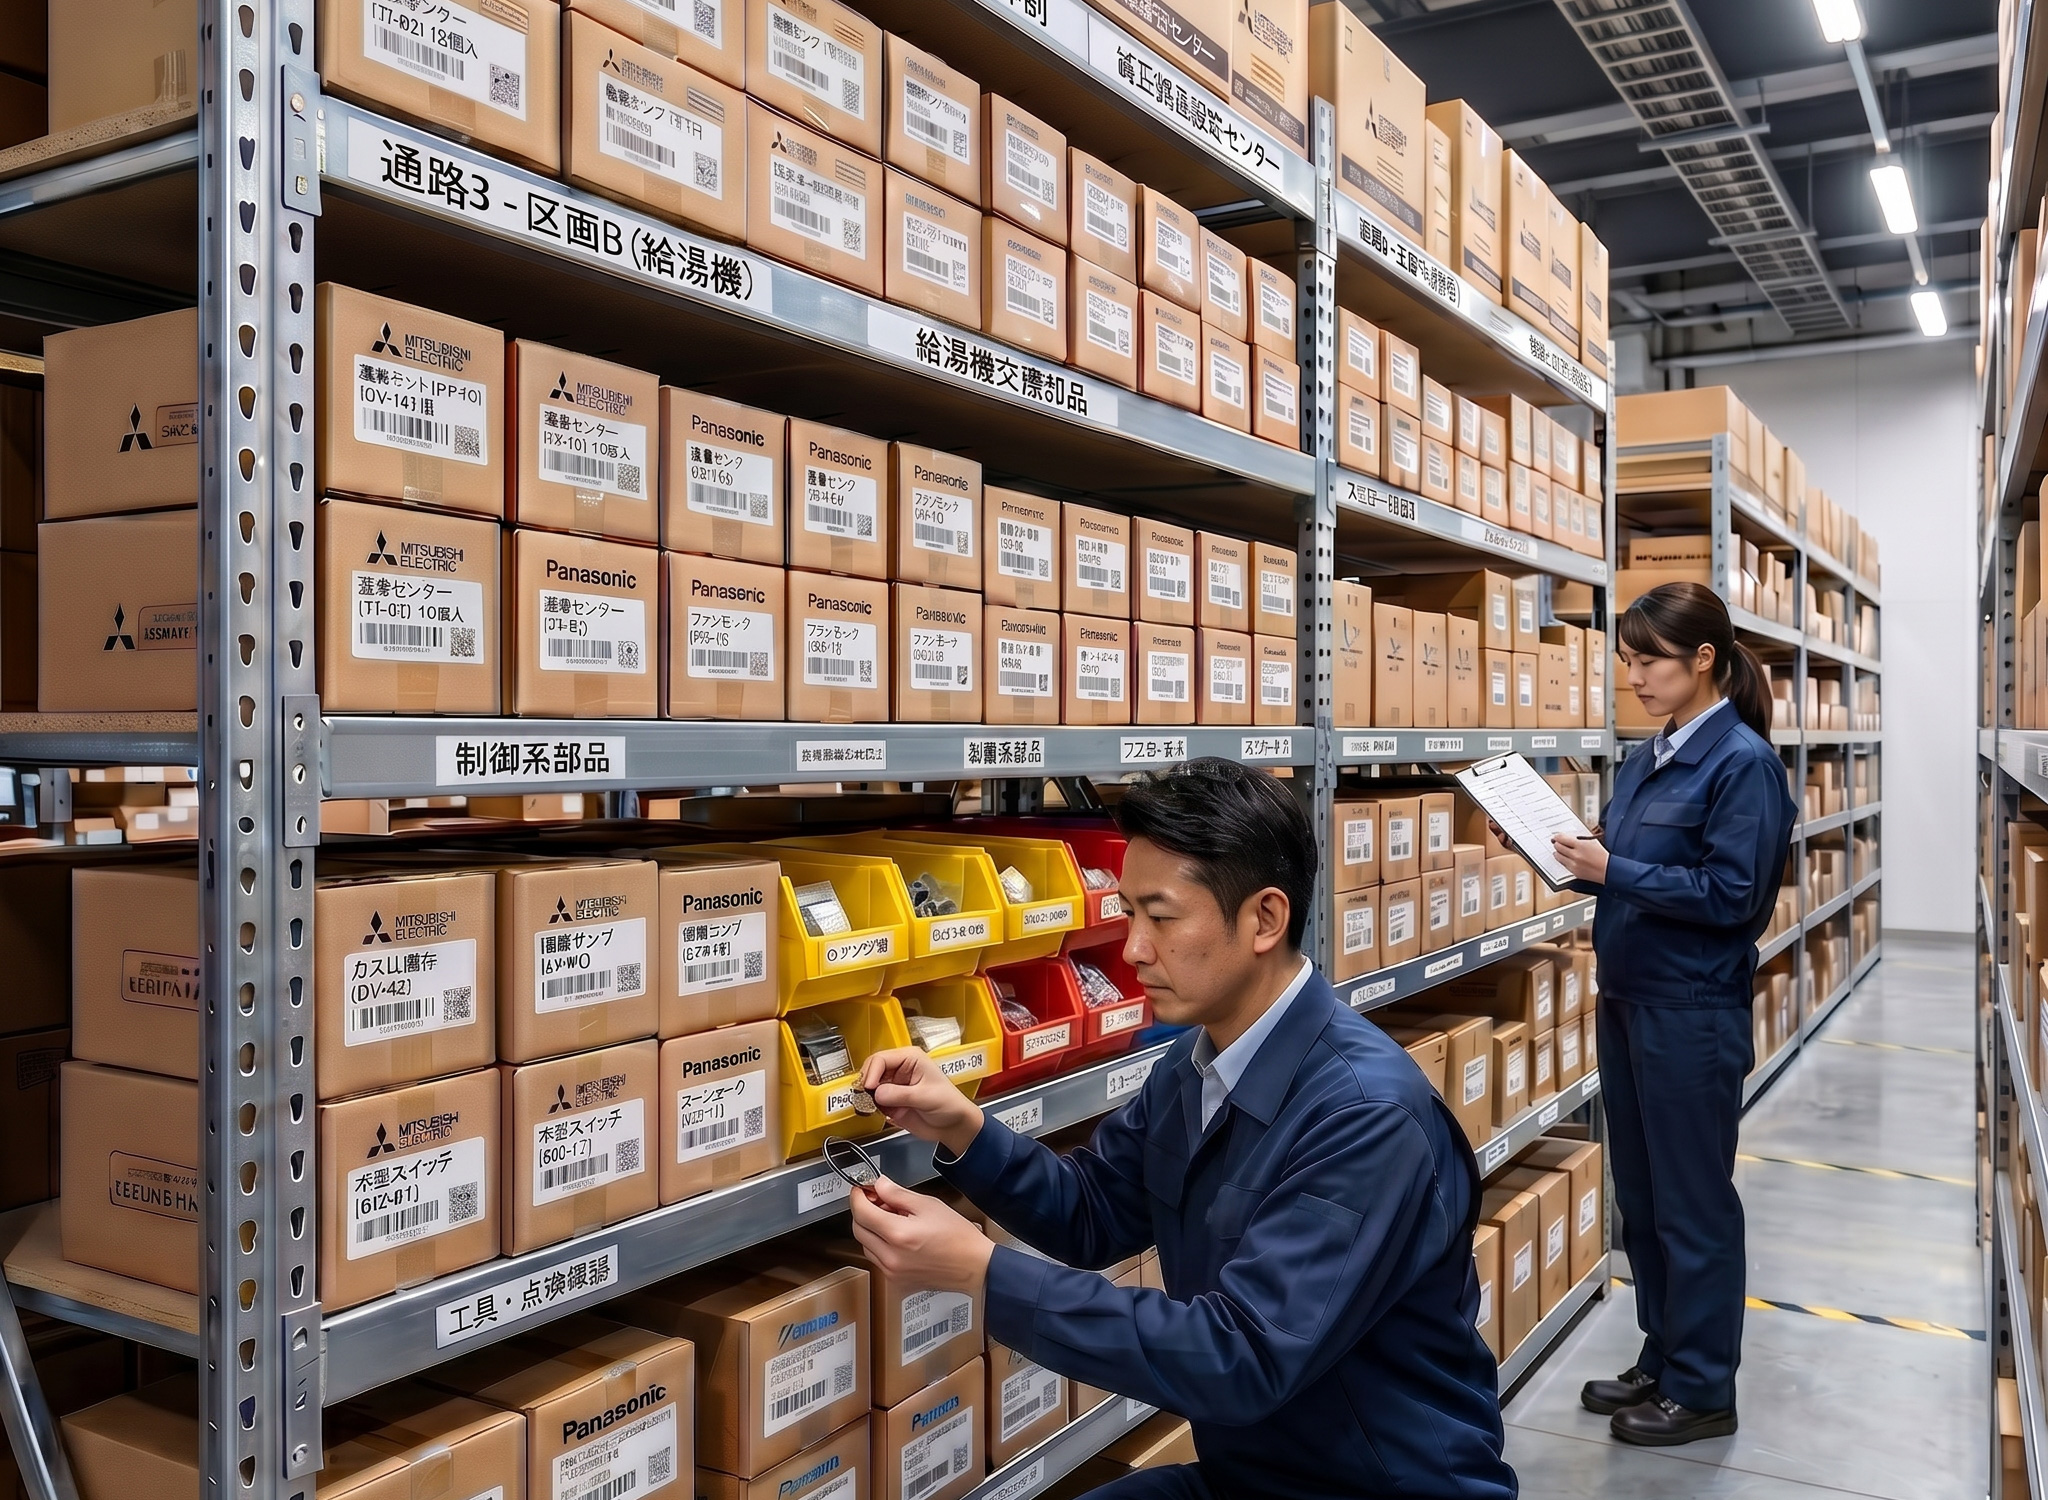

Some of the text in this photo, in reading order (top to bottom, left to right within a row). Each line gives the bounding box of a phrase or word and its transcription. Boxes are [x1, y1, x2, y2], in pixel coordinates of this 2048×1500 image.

[380, 139, 491, 212] 通路3
[692, 414, 765, 447] Panasonic
[809, 441, 872, 471] Panasonic
[400, 556, 457, 573] ELECTRIC
[546, 559, 637, 590] Panasonic
[455, 741, 610, 777] 制御系部品
[682, 887, 763, 914] Panasonic
[682, 1045, 761, 1079] Panasonic
[563, 1383, 667, 1445] Panasonic
